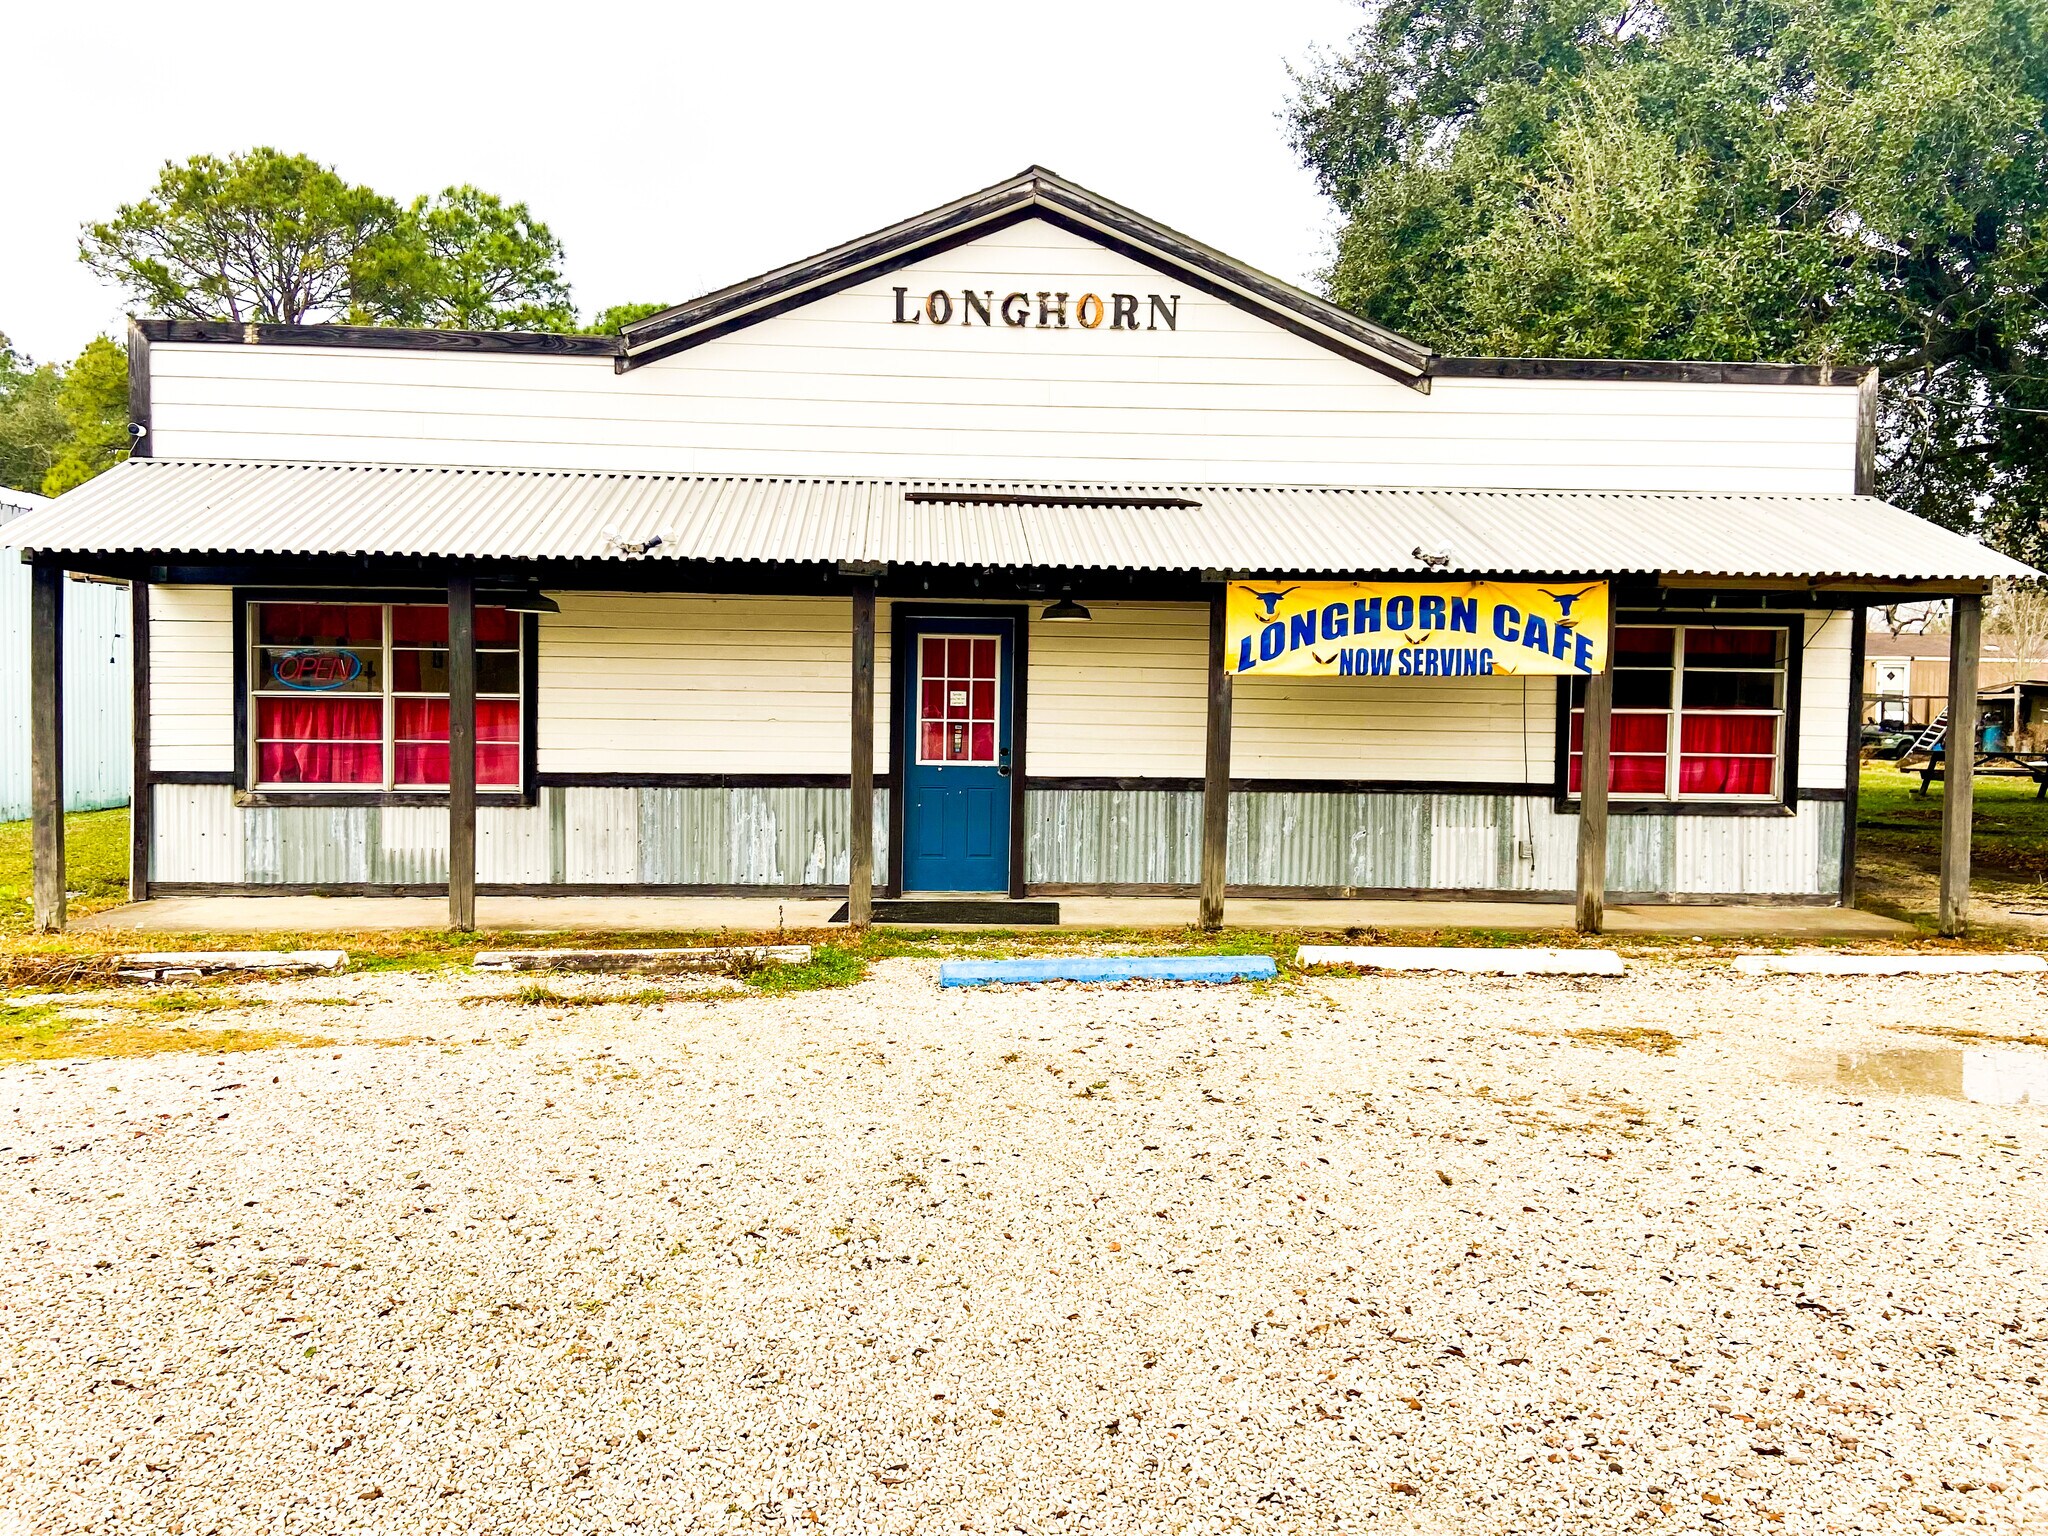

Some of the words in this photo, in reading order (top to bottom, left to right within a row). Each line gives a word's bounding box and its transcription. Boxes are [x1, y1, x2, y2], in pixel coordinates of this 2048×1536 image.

[892, 286, 1181, 331] LONGHORN
[1237, 595, 1478, 673] LONGHORN
[1492, 604, 1594, 675] CAFE
[279, 656, 353, 681] OPEN
[1339, 647, 1394, 677] NOW
[1398, 647, 1494, 677] SERVING
